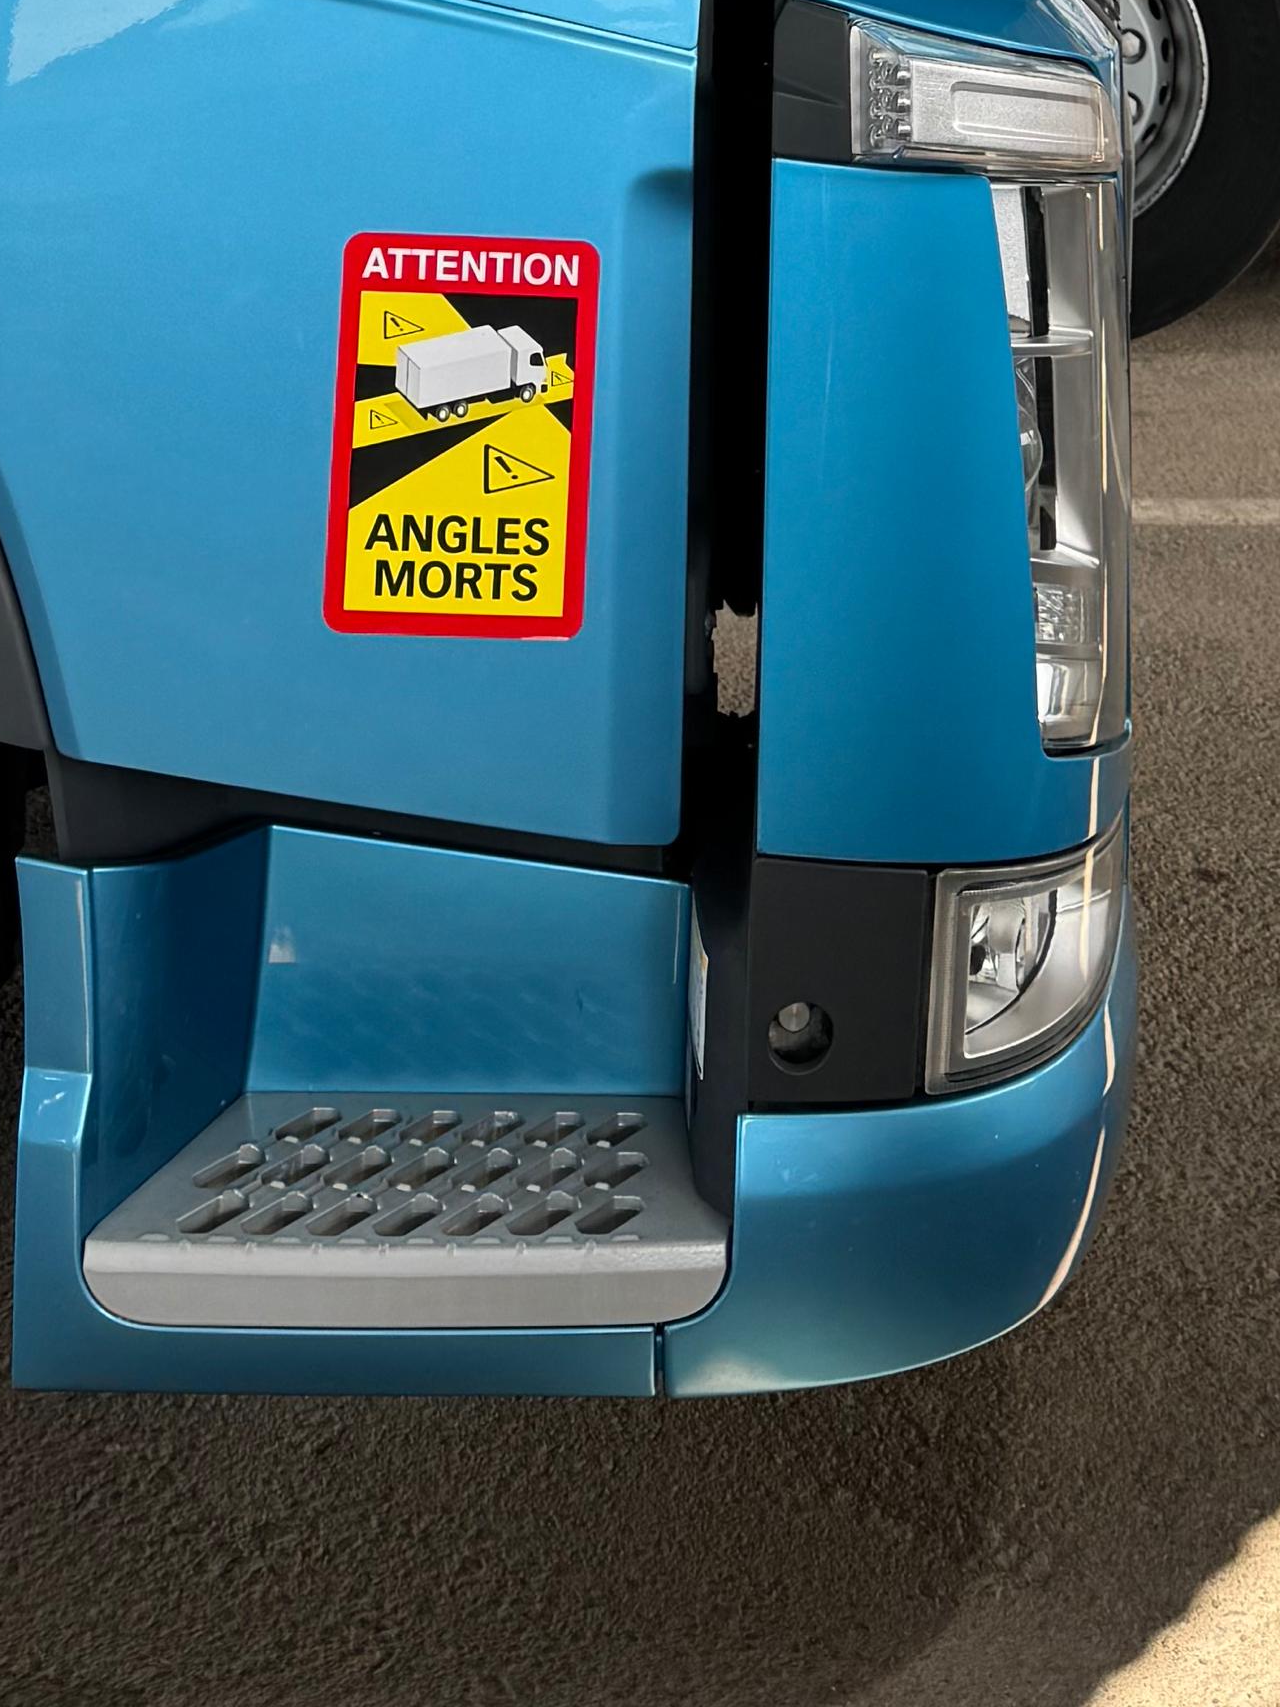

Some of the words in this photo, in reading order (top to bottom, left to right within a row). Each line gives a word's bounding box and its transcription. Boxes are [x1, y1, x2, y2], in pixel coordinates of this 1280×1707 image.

[361, 247, 580, 287] ATTENTION
[364, 513, 550, 557] ANGLES
[374, 560, 538, 602] MORTS
